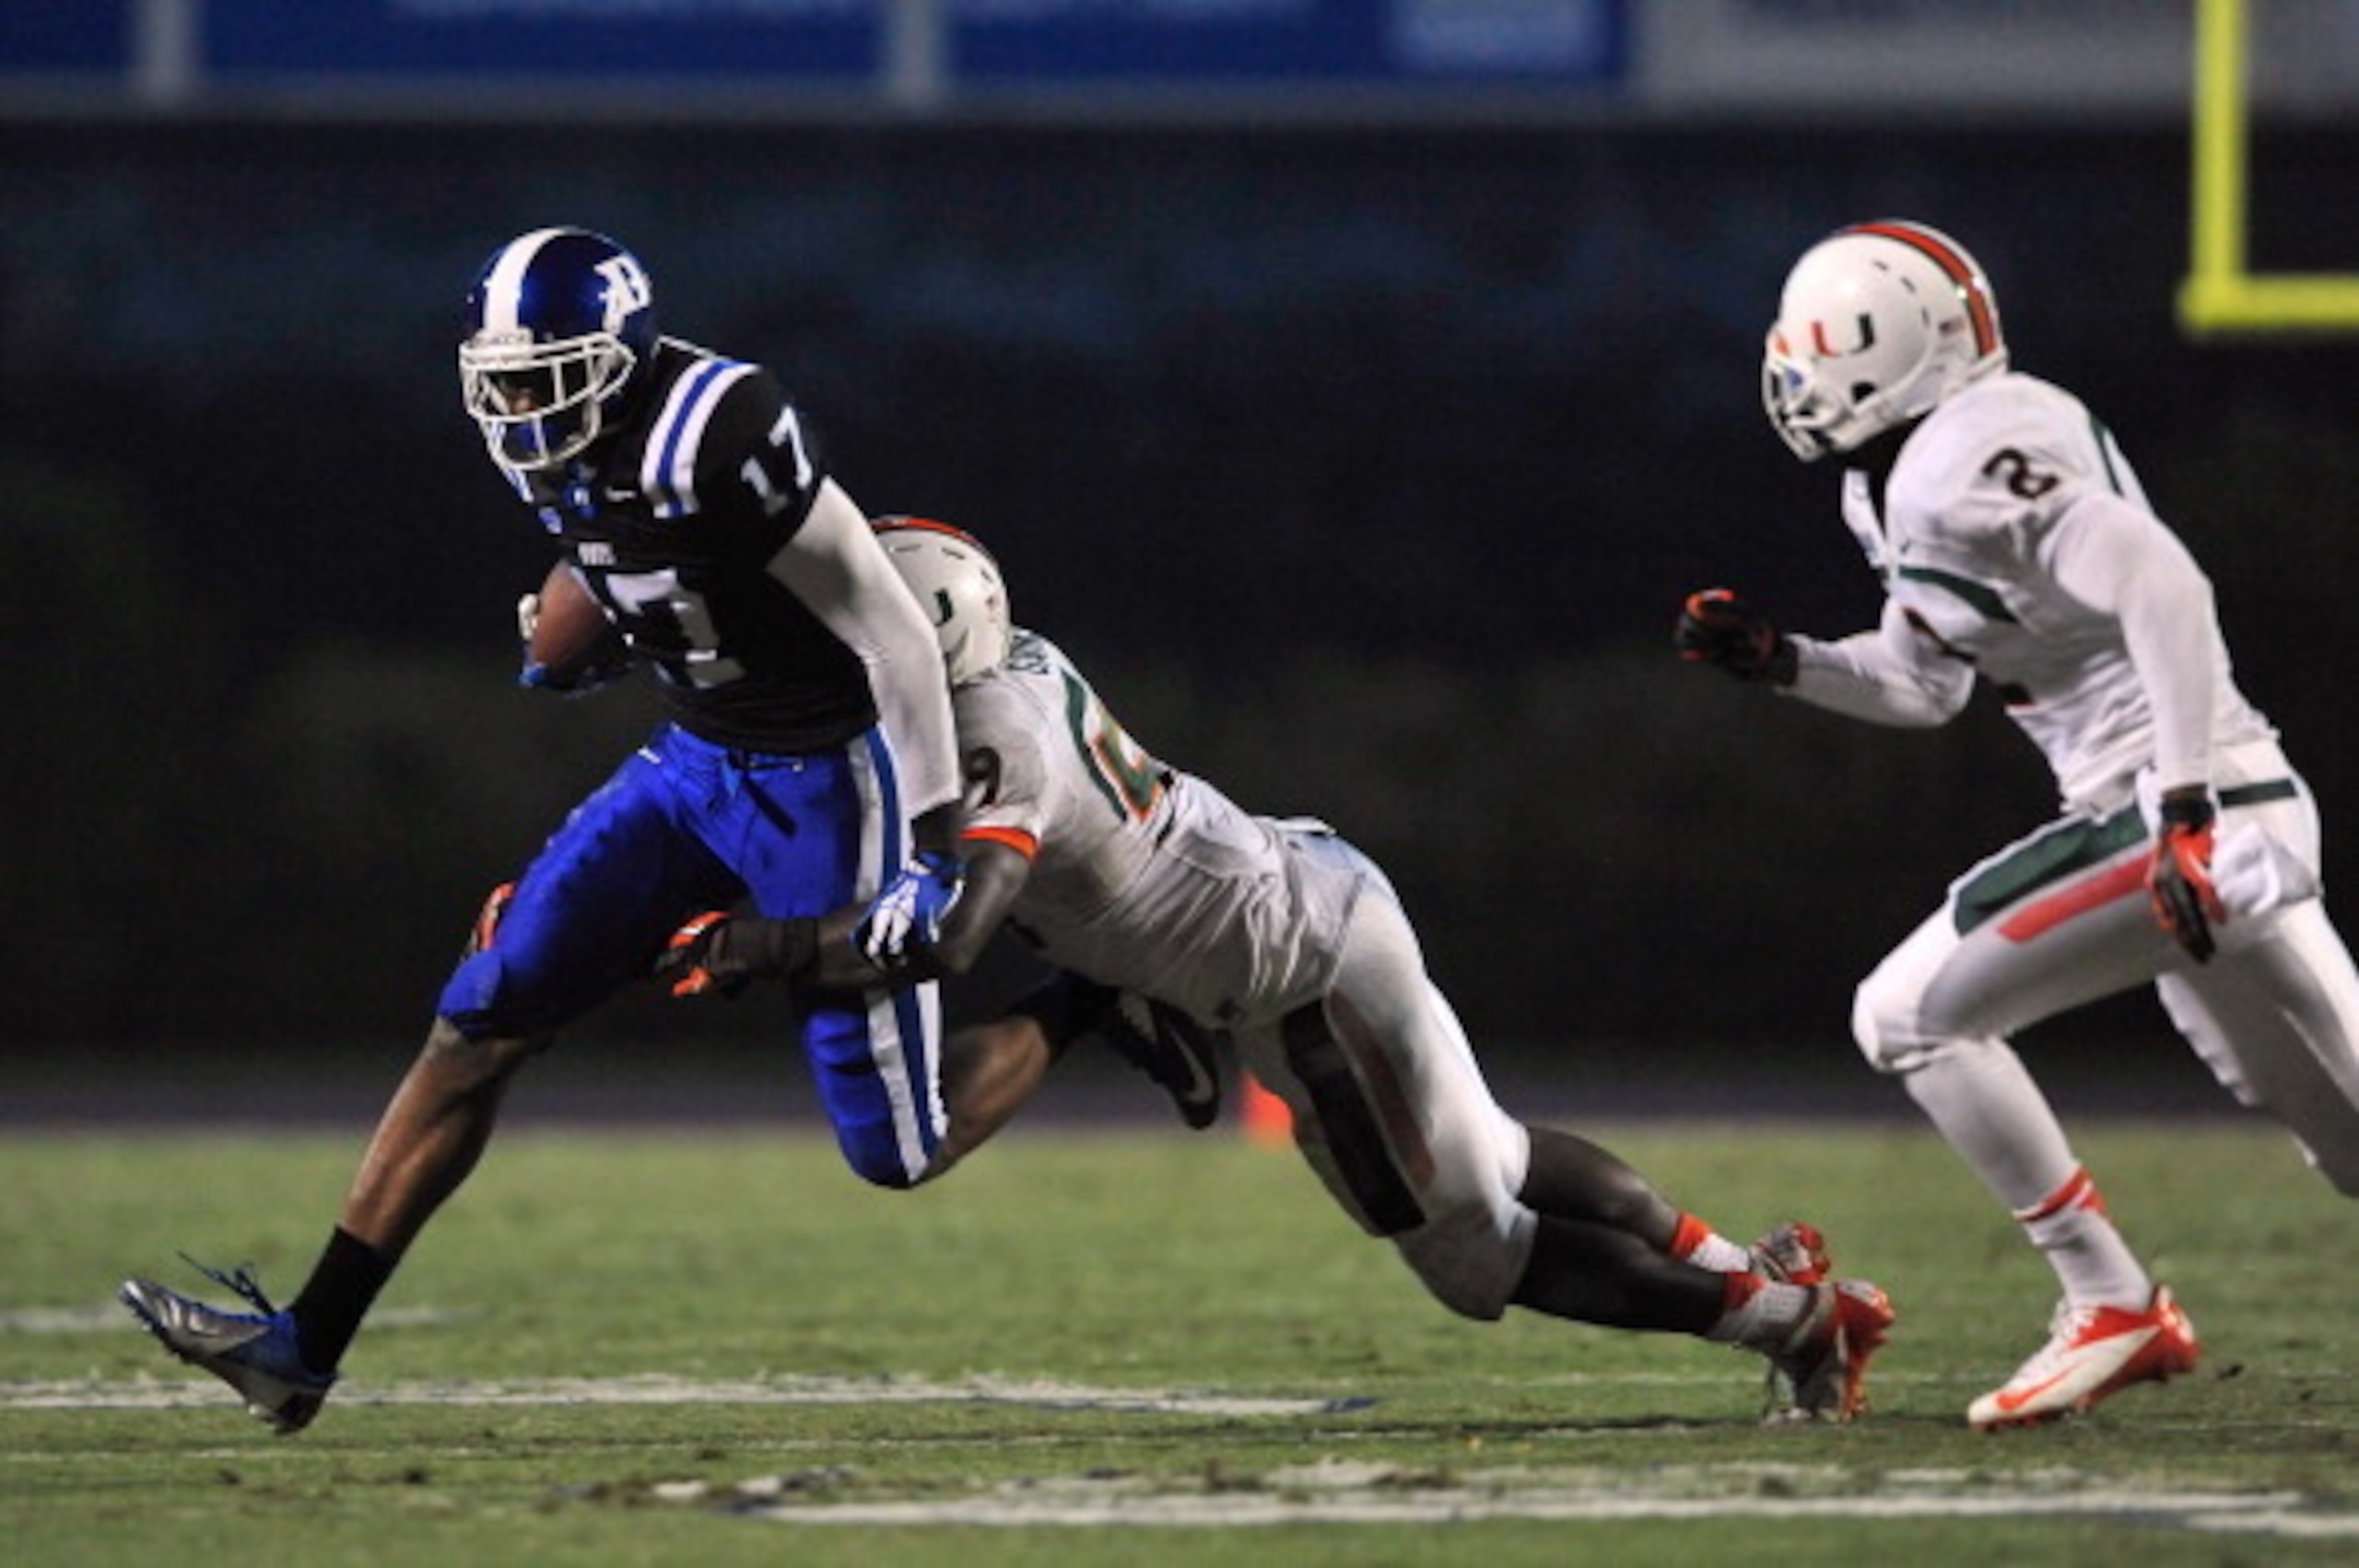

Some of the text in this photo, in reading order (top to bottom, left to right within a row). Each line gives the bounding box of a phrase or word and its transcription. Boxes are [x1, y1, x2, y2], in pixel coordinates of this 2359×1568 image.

[1812, 311, 1874, 357] U
[740, 405, 812, 515] 17
[1983, 448, 2060, 499] 2
